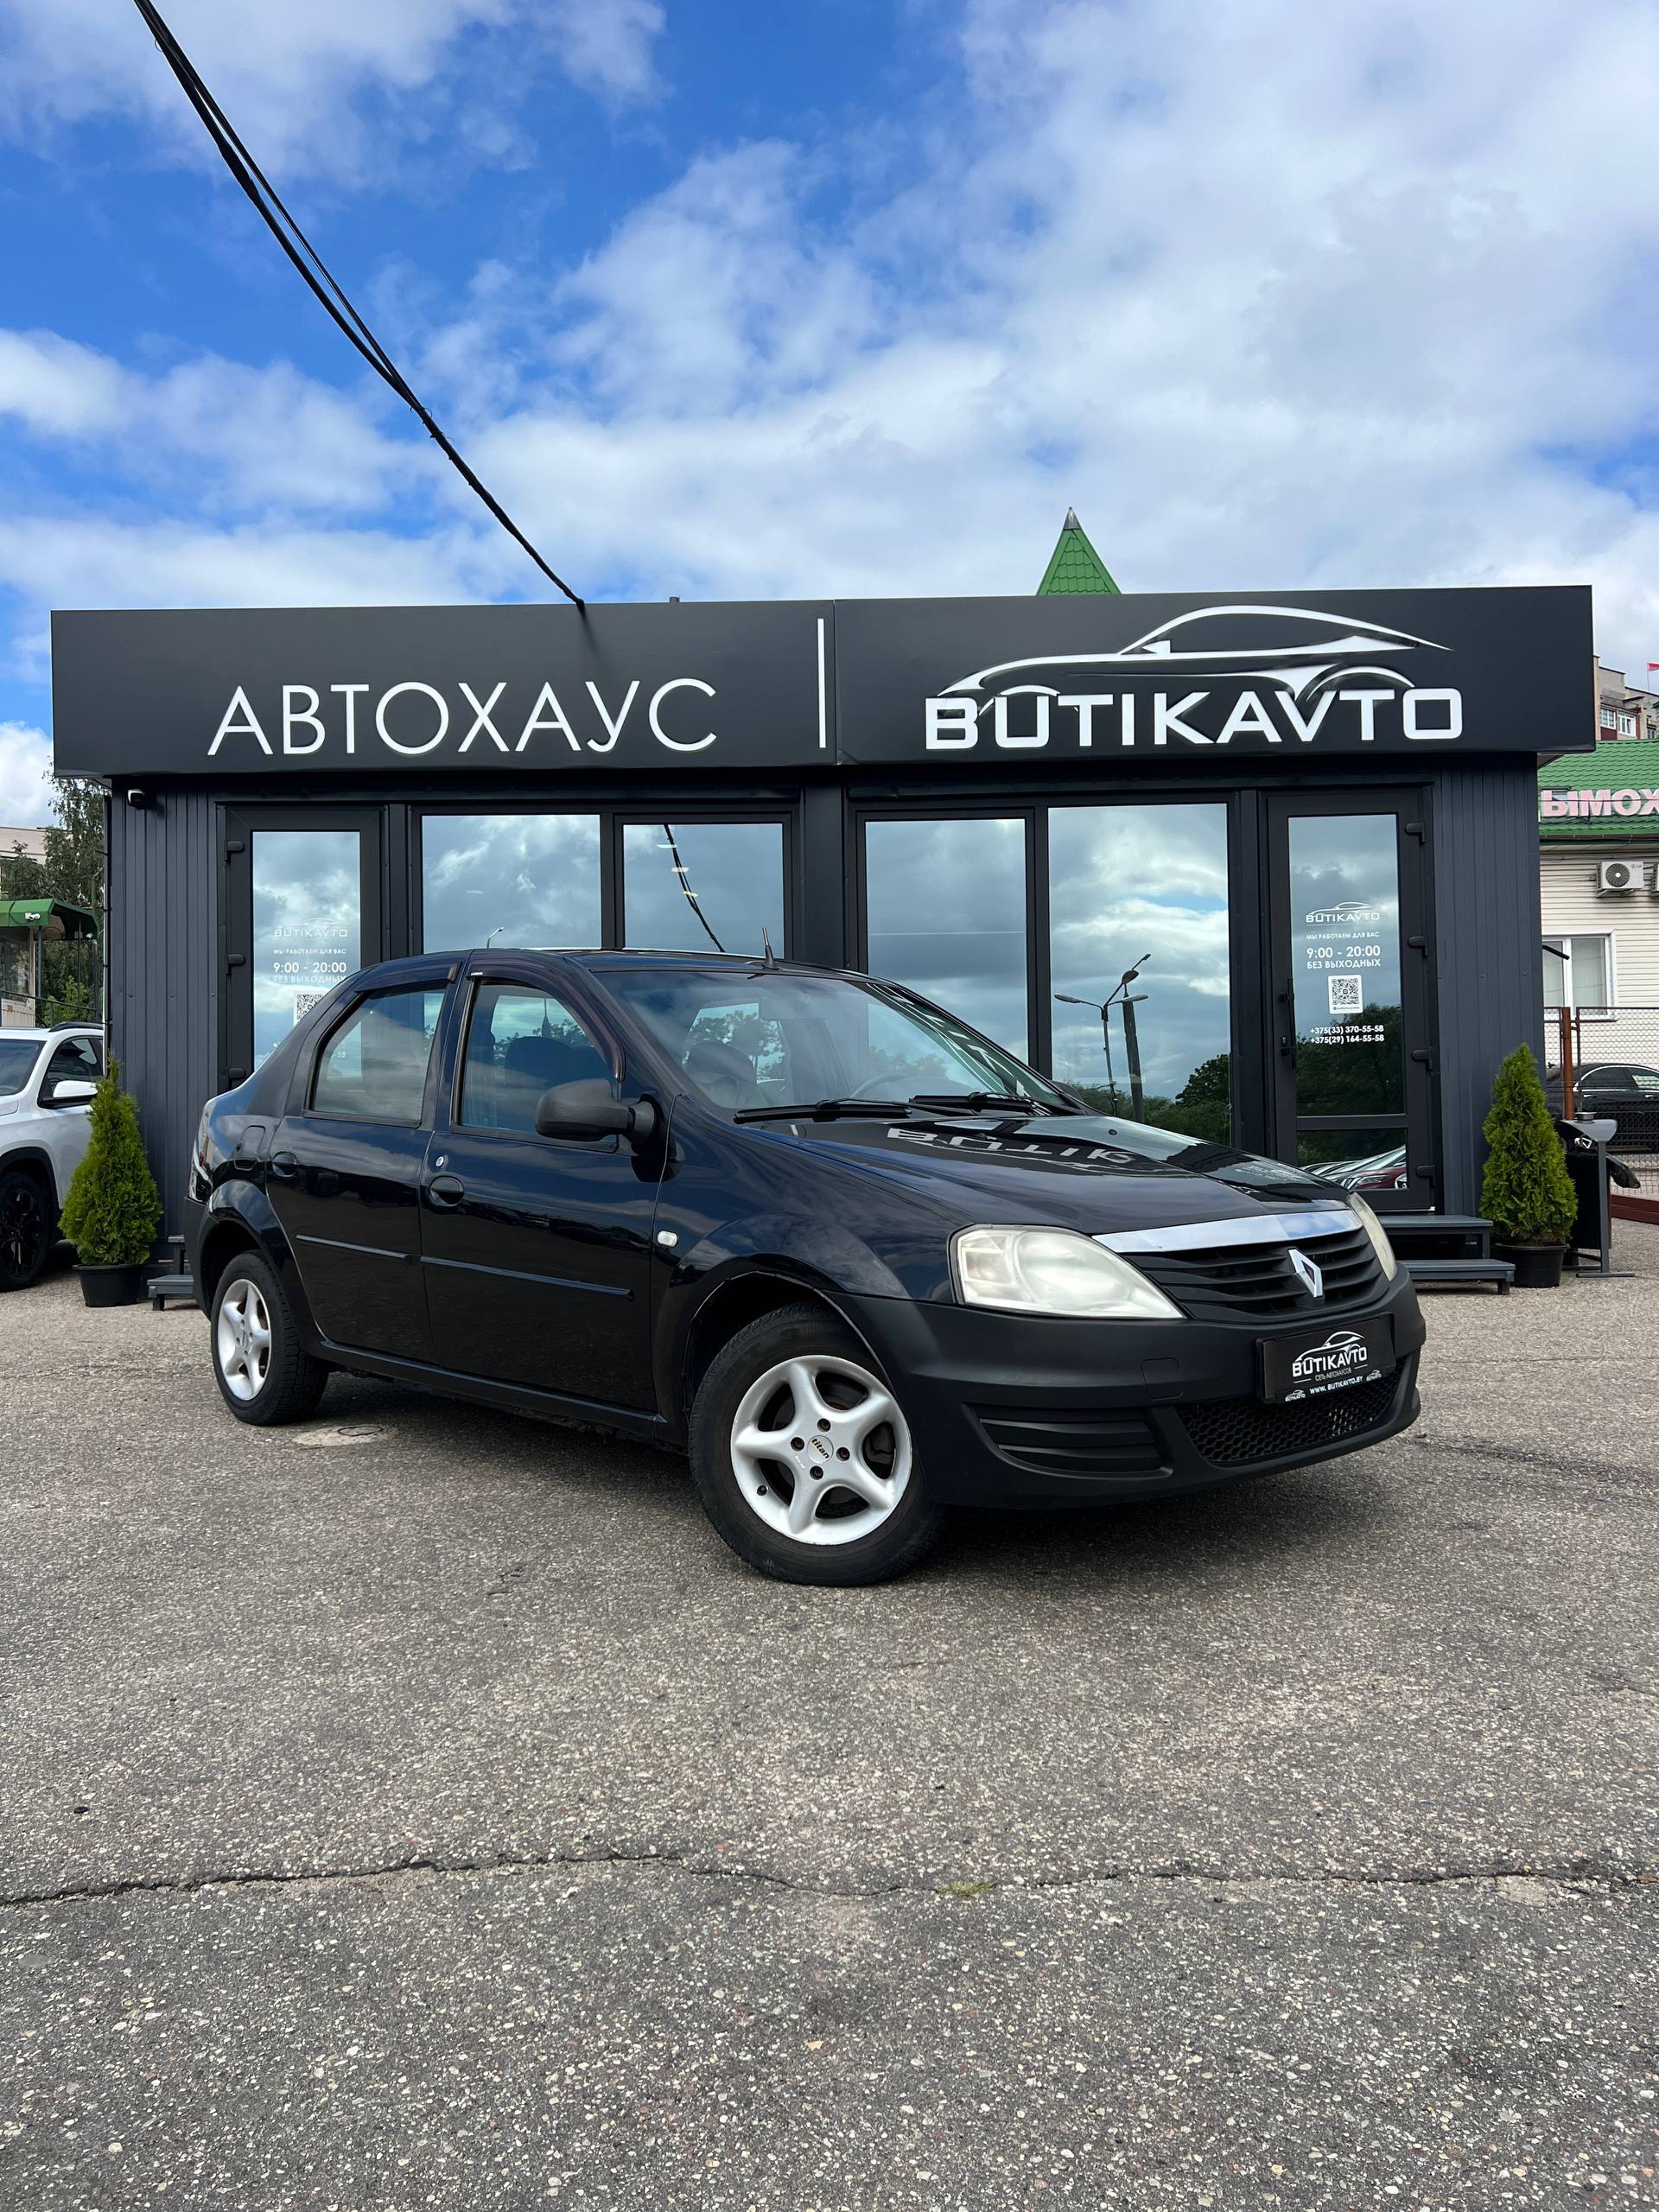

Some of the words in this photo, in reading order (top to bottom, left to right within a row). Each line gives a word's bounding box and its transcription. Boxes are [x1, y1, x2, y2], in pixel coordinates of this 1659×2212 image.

[207, 677, 718, 756] АВТОХАУС
[925, 688, 1464, 750] BUTIKAVTO
[1306, 912, 1381, 923] BUTIKAVTO
[275, 928, 348, 938] BUTIKAVTO
[1306, 947, 1333, 959] 9:00
[1346, 945, 1381, 957] 20:00
[273, 962, 300, 973] 9:00
[312, 962, 346, 973] 20:00
[1306, 961, 1323, 969] БЕЗ
[1325, 958, 1382, 969] ВЫХОДНЫХ
[1310, 1026, 1344, 1035] +375(33)
[1344, 1025, 1384, 1033] 370-55-58
[1310, 1035, 1344, 1045] +375(29)
[1345, 1034, 1385, 1043] 164-55-58
[1293, 1346, 1368, 1377] BUTIKAVTO
